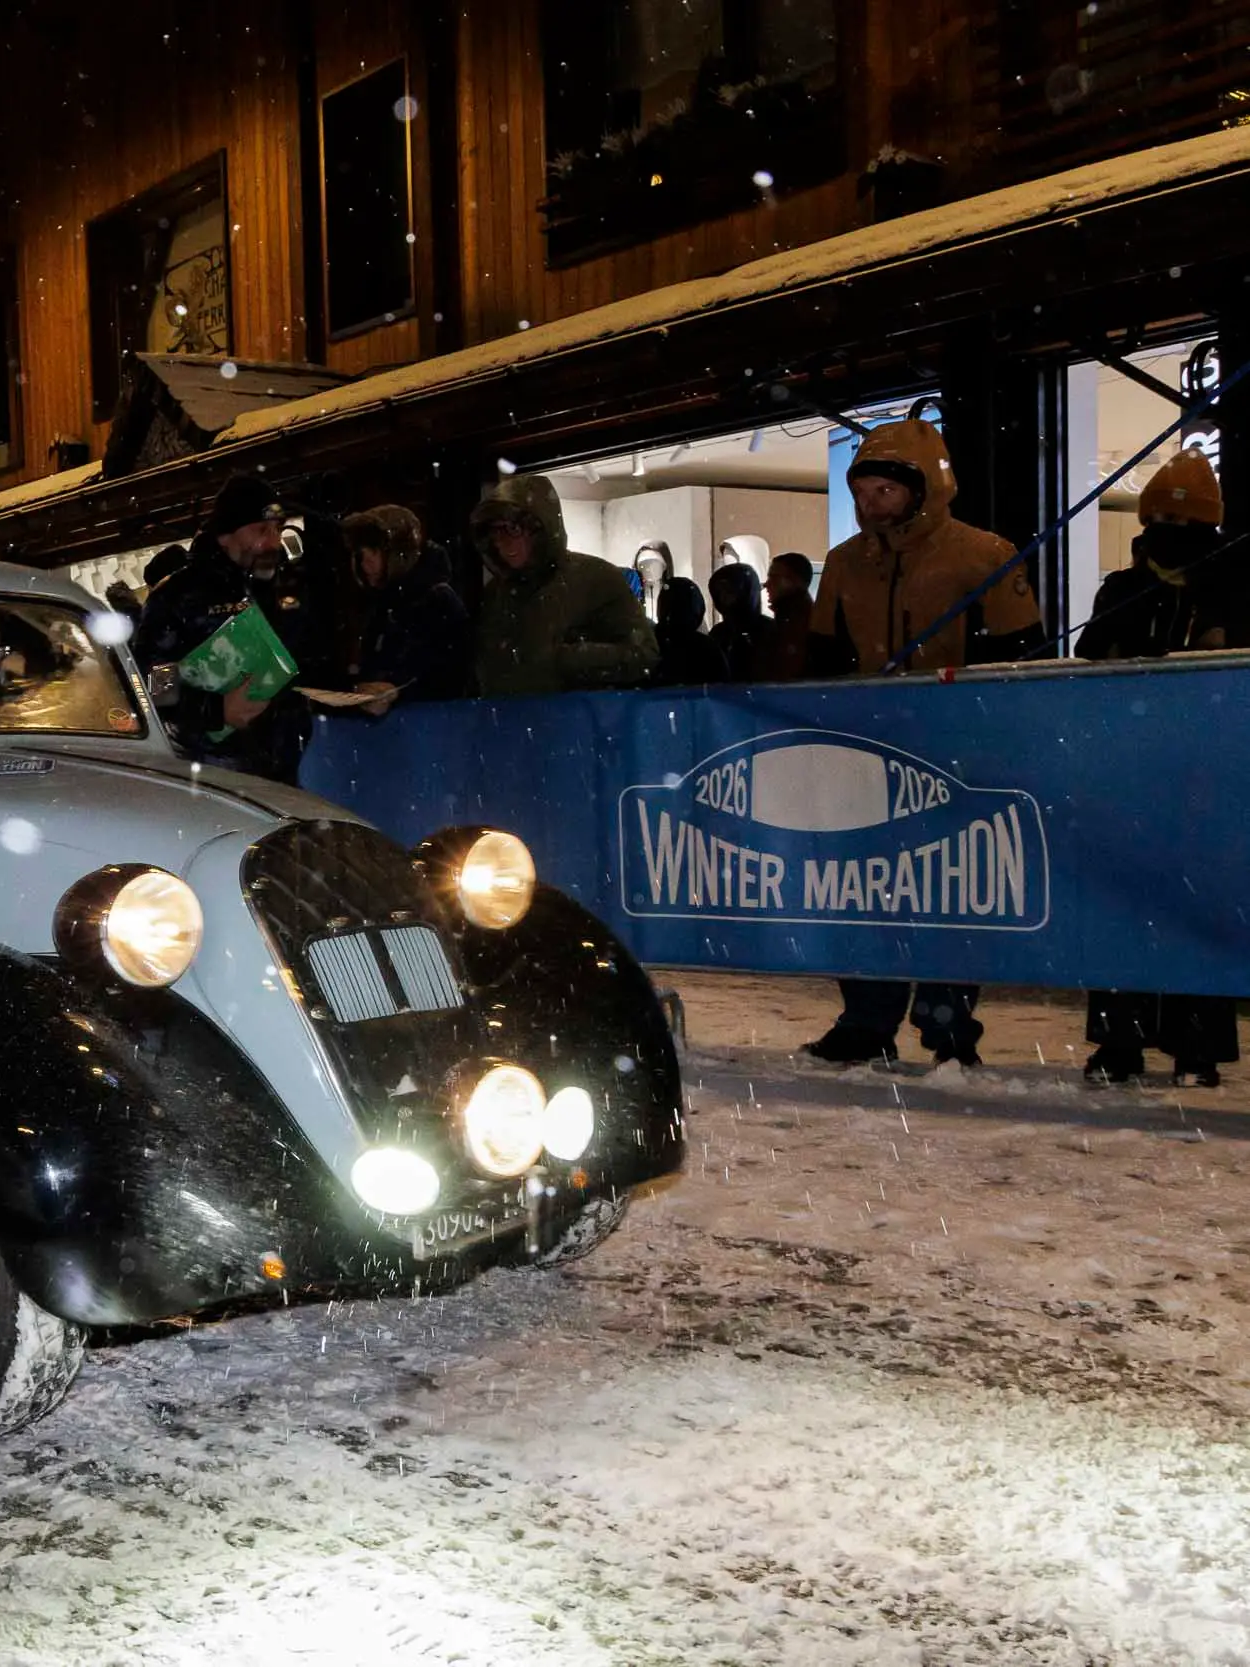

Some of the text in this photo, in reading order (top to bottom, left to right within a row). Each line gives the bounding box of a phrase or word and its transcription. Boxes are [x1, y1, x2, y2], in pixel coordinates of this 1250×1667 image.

[694, 757, 951, 819] 2026 2026
[637, 798, 1024, 917] WINTER MARATHON
